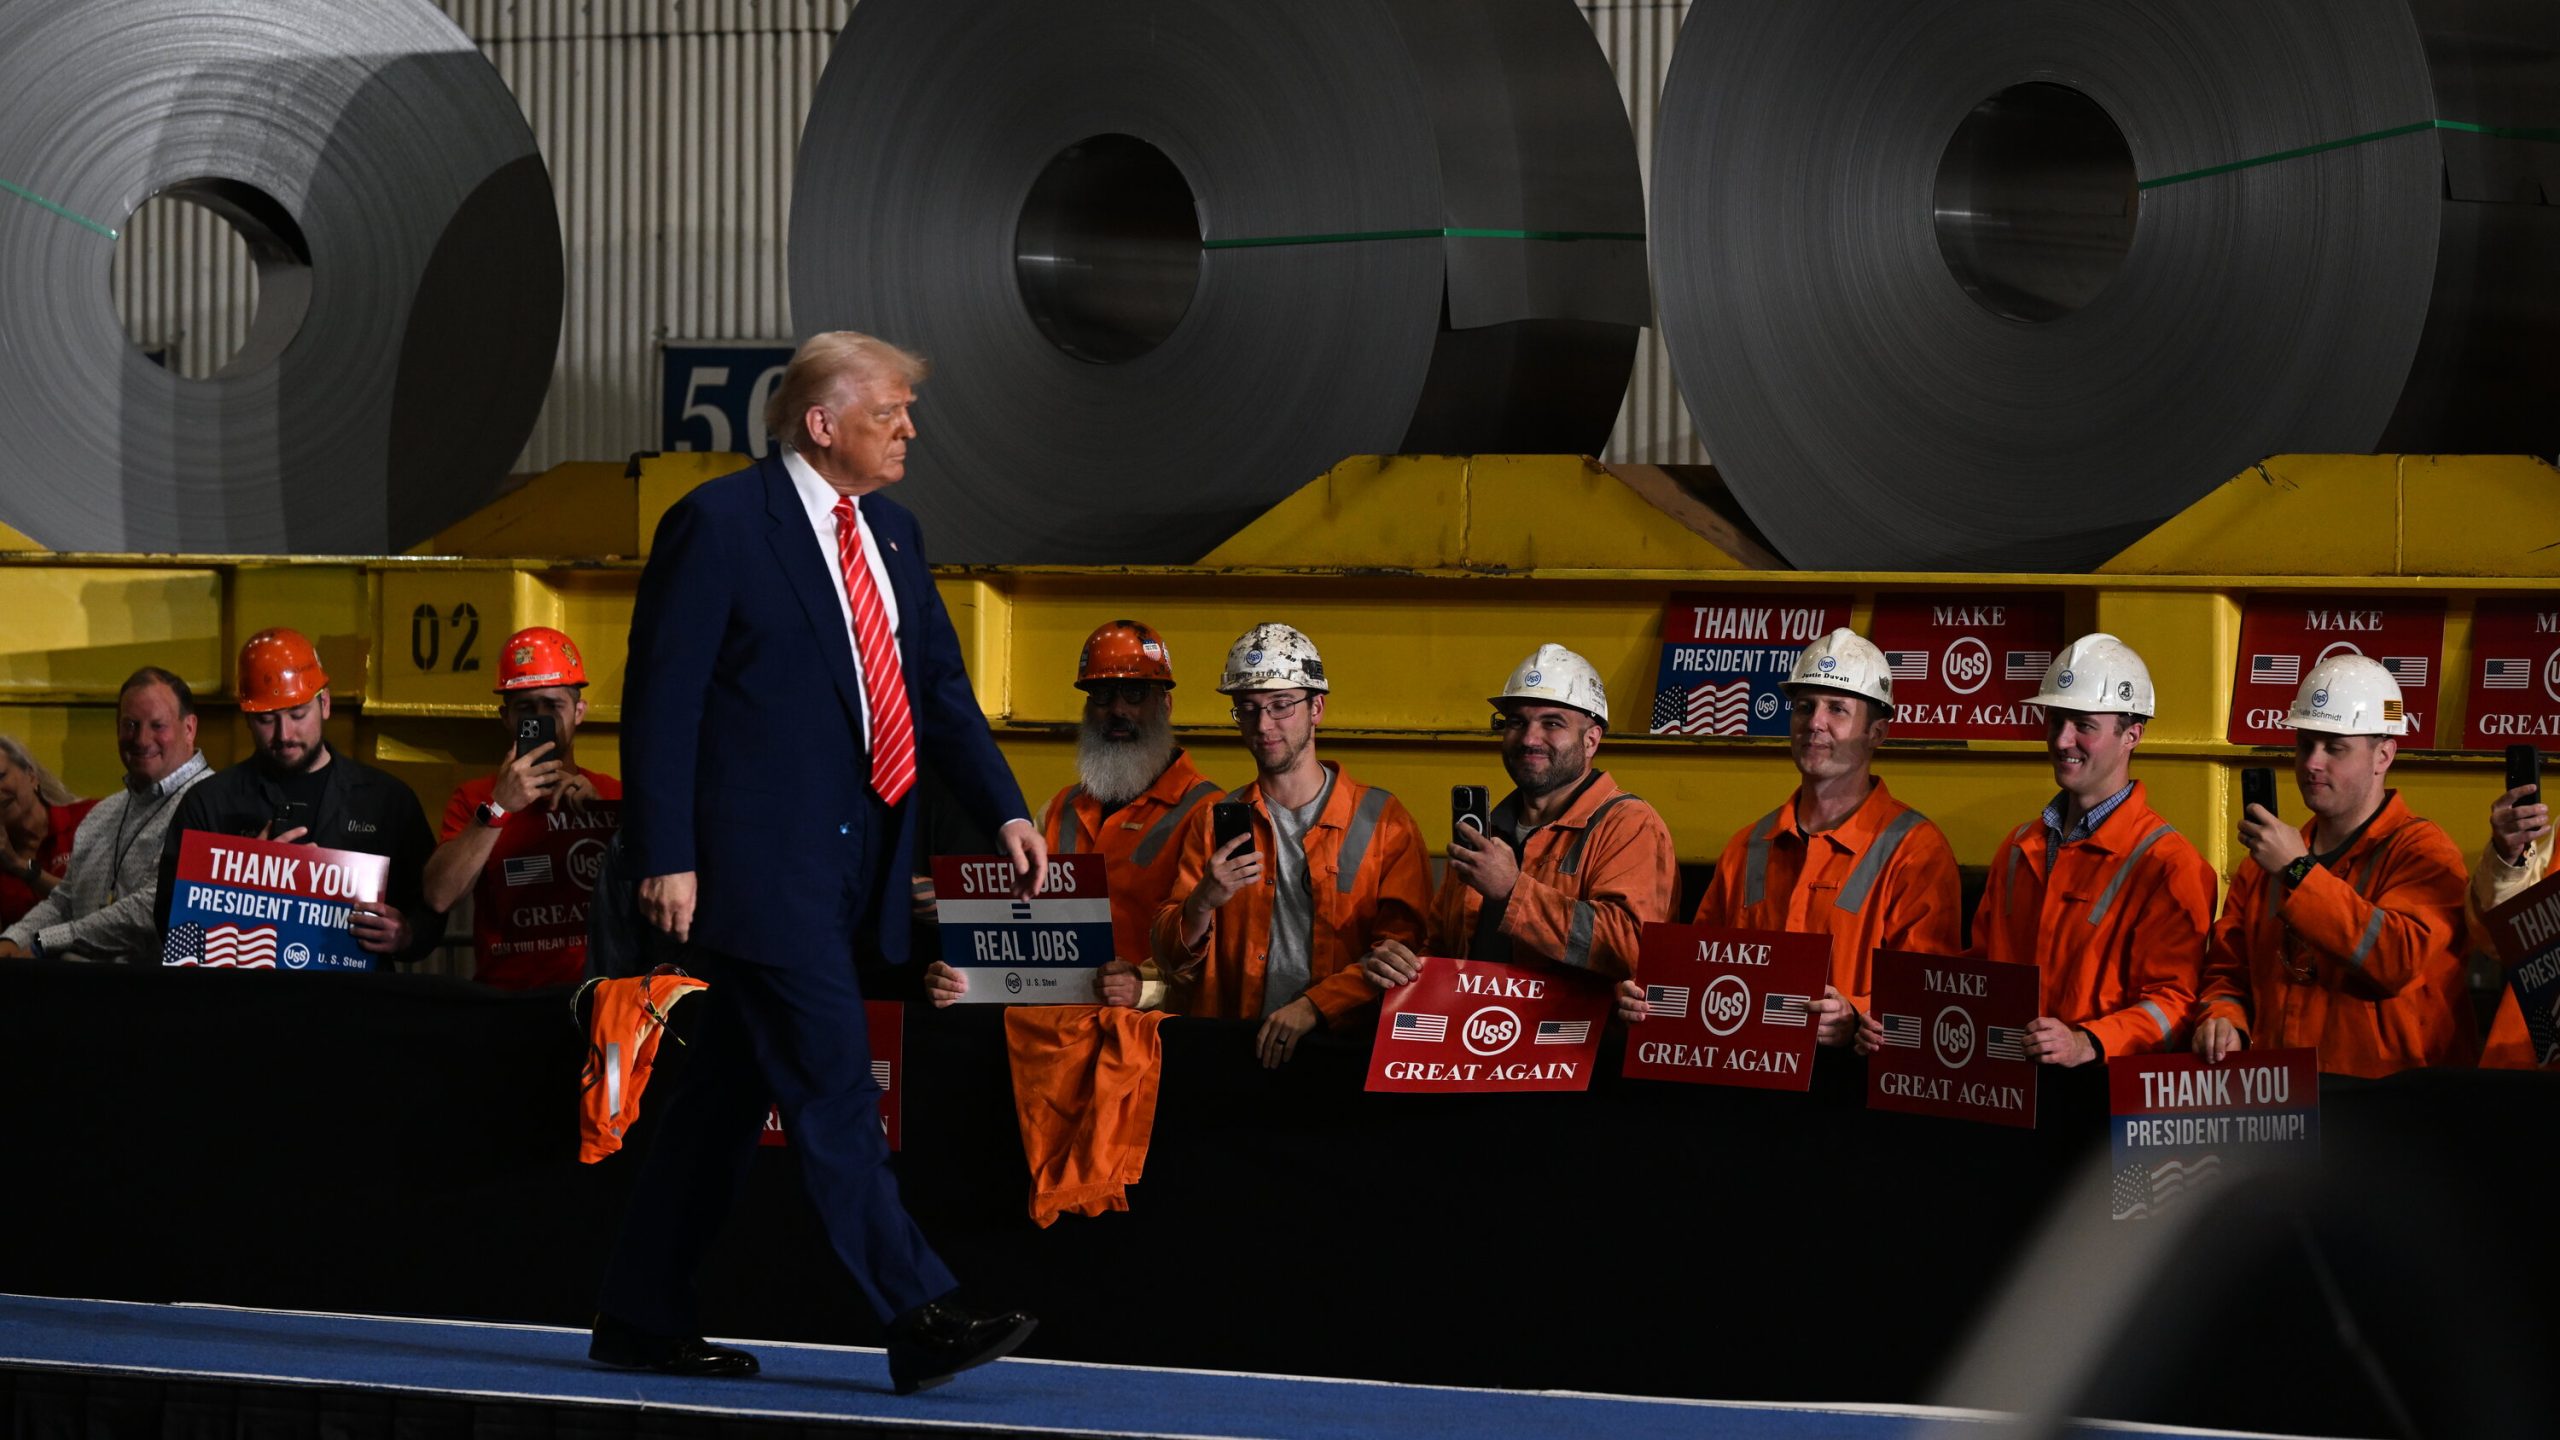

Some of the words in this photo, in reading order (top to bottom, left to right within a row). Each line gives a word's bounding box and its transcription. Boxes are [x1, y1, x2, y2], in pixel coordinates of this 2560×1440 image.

[1693, 606, 1773, 640] THANK
[1780, 608, 1826, 641] YOU
[1931, 605, 2007, 627] MAKE
[2304, 609, 2384, 631] MAKE
[412, 602, 480, 672] 02
[1672, 647, 1768, 673] PRESIDENT
[1769, 649, 1802, 673] TRU
[1949, 651, 1985, 681] USS
[1758, 700, 1776, 713] USS
[1966, 704, 2047, 726] AGAIN
[2311, 709, 2342, 722] Schmidt
[545, 810, 621, 833] MAKE
[209, 846, 301, 892] THANK
[308, 860, 359, 898] YOU
[1043, 861, 1077, 894] BS
[187, 885, 294, 923] PRESIDENT
[298, 900, 354, 931] TRUM
[286, 949, 307, 964] USS
[973, 930, 1027, 962] REAL
[1031, 930, 1080, 962] JOBS
[1695, 940, 1772, 967] MAKE
[342, 956, 368, 970] Steel
[2518, 946, 2560, 993] PRESI
[1041, 978, 1057, 987] Steel
[1454, 972, 1546, 1000] MAKE
[1922, 968, 1989, 998] MAKE
[1707, 990, 1745, 1022] USS
[1470, 1019, 1514, 1046] USS
[1938, 1021, 1970, 1054] USS
[1383, 1060, 1483, 1081] GREAT
[1485, 1061, 1579, 1081] AGAIN
[1638, 1041, 1720, 1069] GREAT
[1722, 1048, 1801, 1075] AGAIN
[1879, 1071, 1953, 1102] GREAT
[1957, 1082, 2025, 1112] AGAIN
[2139, 1068, 2232, 1109] THANK
[2239, 1065, 2290, 1105] YOU
[2126, 1116, 2231, 1148] PRESIDENT
[2235, 1113, 2306, 1144] TRUMP!
